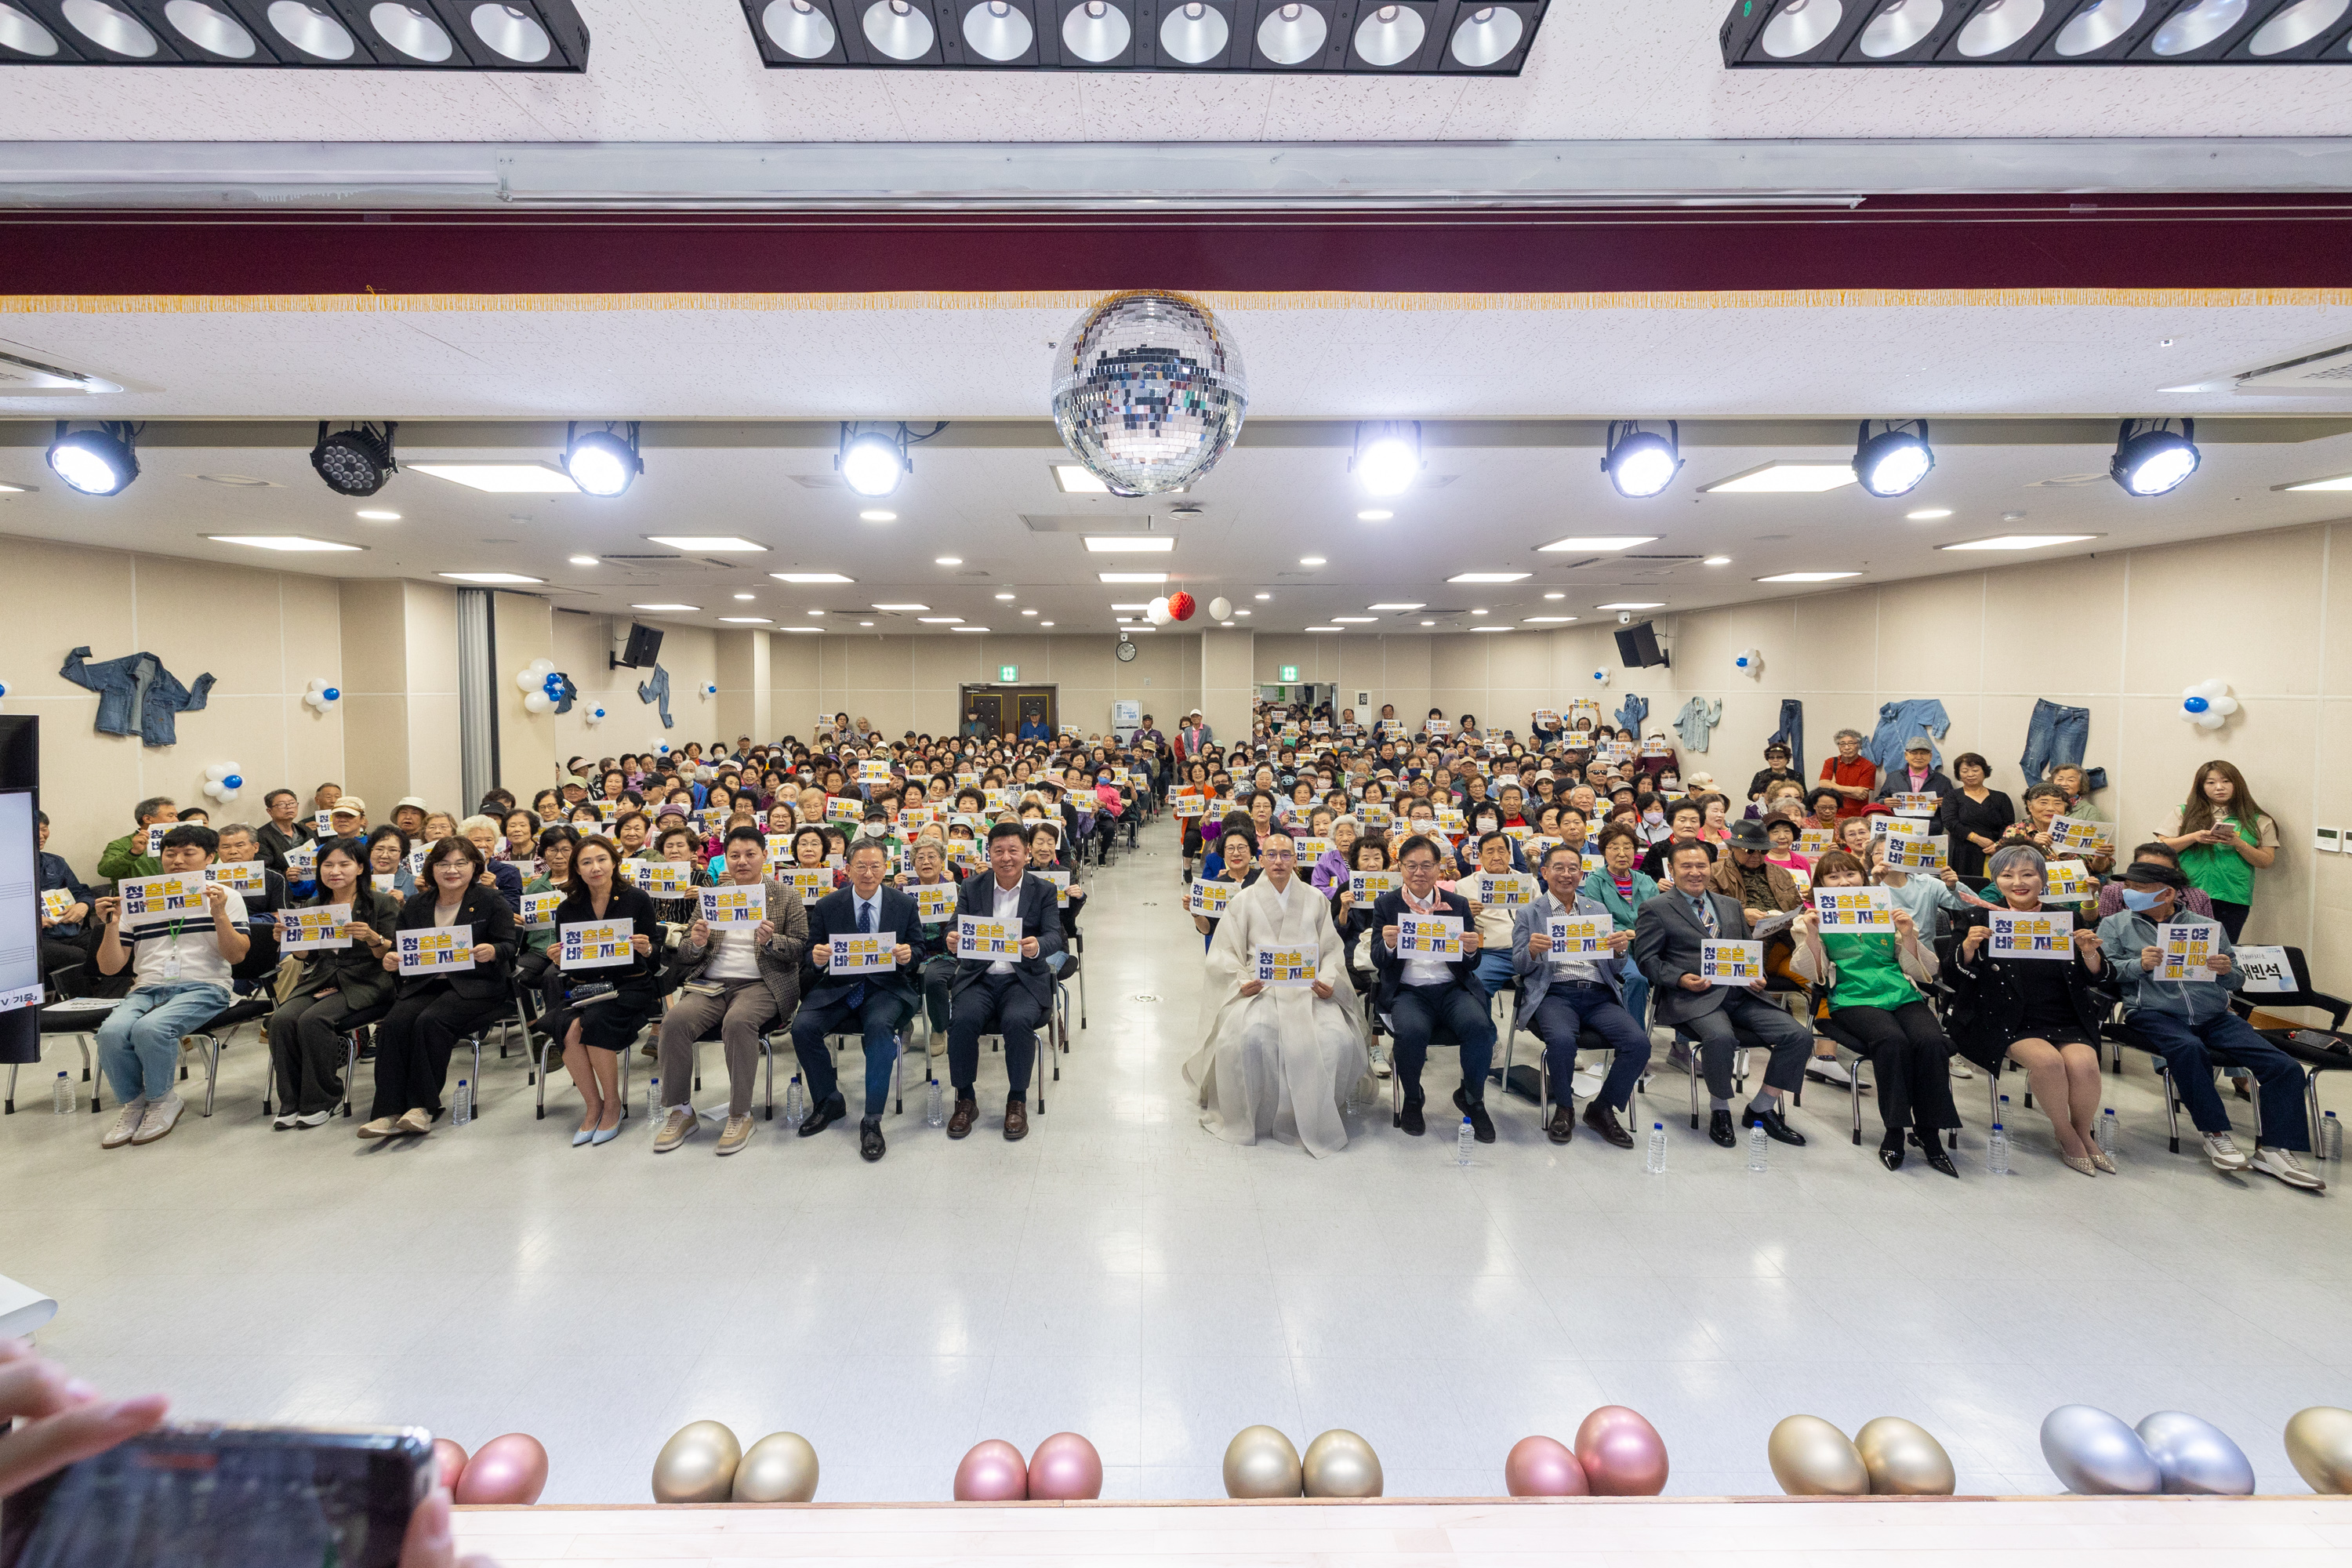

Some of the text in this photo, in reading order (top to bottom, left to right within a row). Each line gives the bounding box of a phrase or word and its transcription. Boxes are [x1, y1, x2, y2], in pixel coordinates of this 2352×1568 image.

[1875, 821, 1913, 834] 청춘은
[2054, 821, 2097, 837] 청춘은
[1297, 841, 1326, 851] 청춘은
[1890, 838, 1936, 855] 청춘은
[639, 866, 675, 880] 청춘은
[125, 880, 183, 899] 청춘은
[1354, 877, 1388, 889] 청춘은
[1482, 880, 1519, 891] 청춘은
[1192, 884, 1227, 900] 청춘은
[524, 896, 561, 912] 청춘은
[703, 893, 747, 908] 청춘은
[1820, 895, 1871, 909] 청춘은
[284, 913, 332, 927] 청춘은
[1995, 920, 2051, 935] 청춘은
[566, 927, 614, 945] 청춘은
[963, 923, 1004, 938] 청춘은
[1403, 921, 1446, 938] 청춘은
[1552, 924, 1595, 937] 청춘은
[402, 935, 452, 952] 청춘은
[833, 940, 878, 953] 청춘은
[1259, 951, 1302, 967] 청춘은
[1704, 946, 1745, 961] 청춘은
